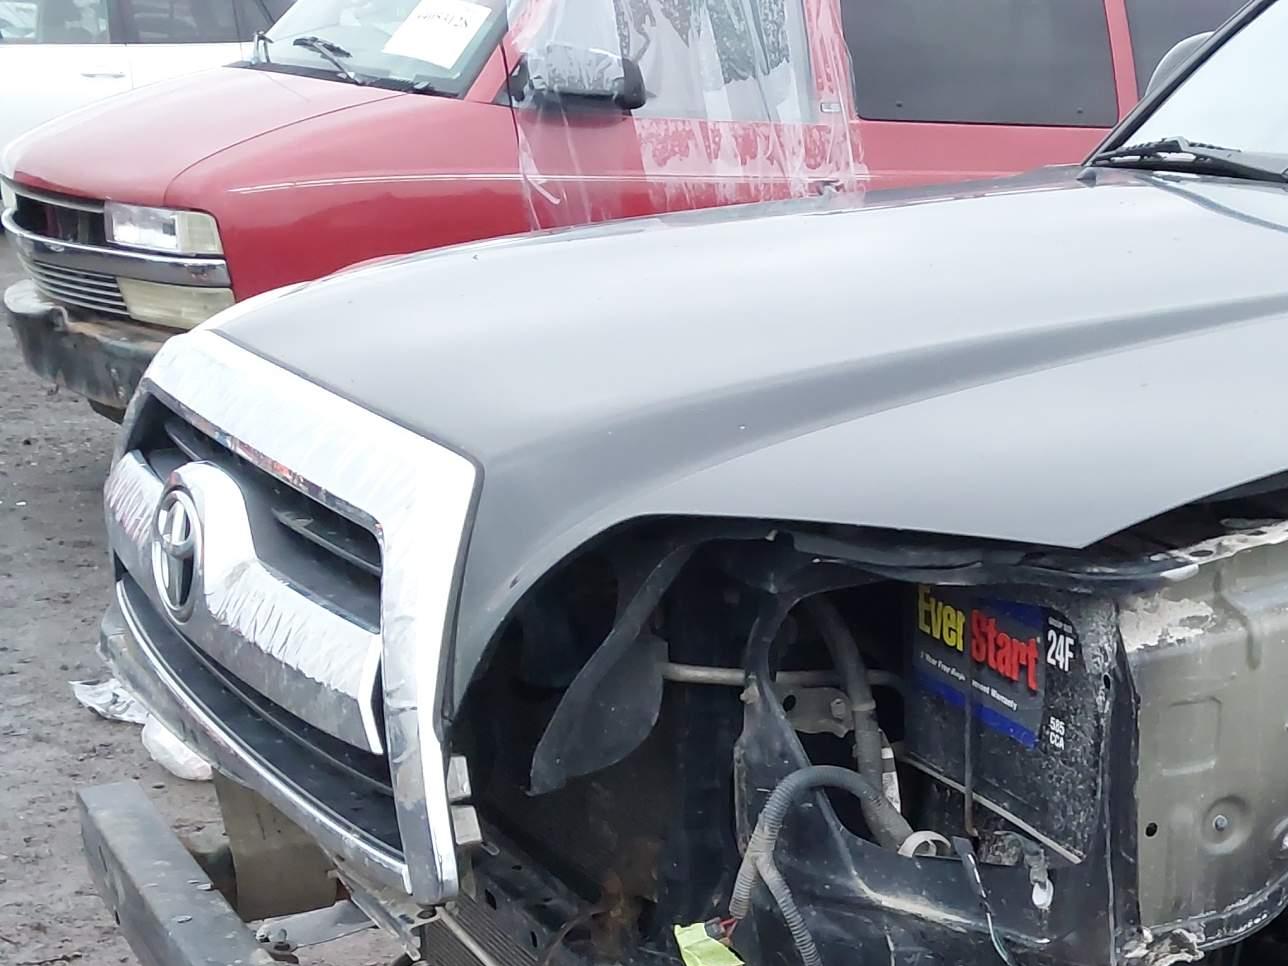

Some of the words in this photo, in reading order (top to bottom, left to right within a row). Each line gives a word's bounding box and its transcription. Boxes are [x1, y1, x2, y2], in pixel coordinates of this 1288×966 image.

[918, 585, 965, 652] Ever
[971, 609, 1039, 692] Start
[1047, 629, 1075, 672] 24F
[1049, 732, 1065, 751] CCA
